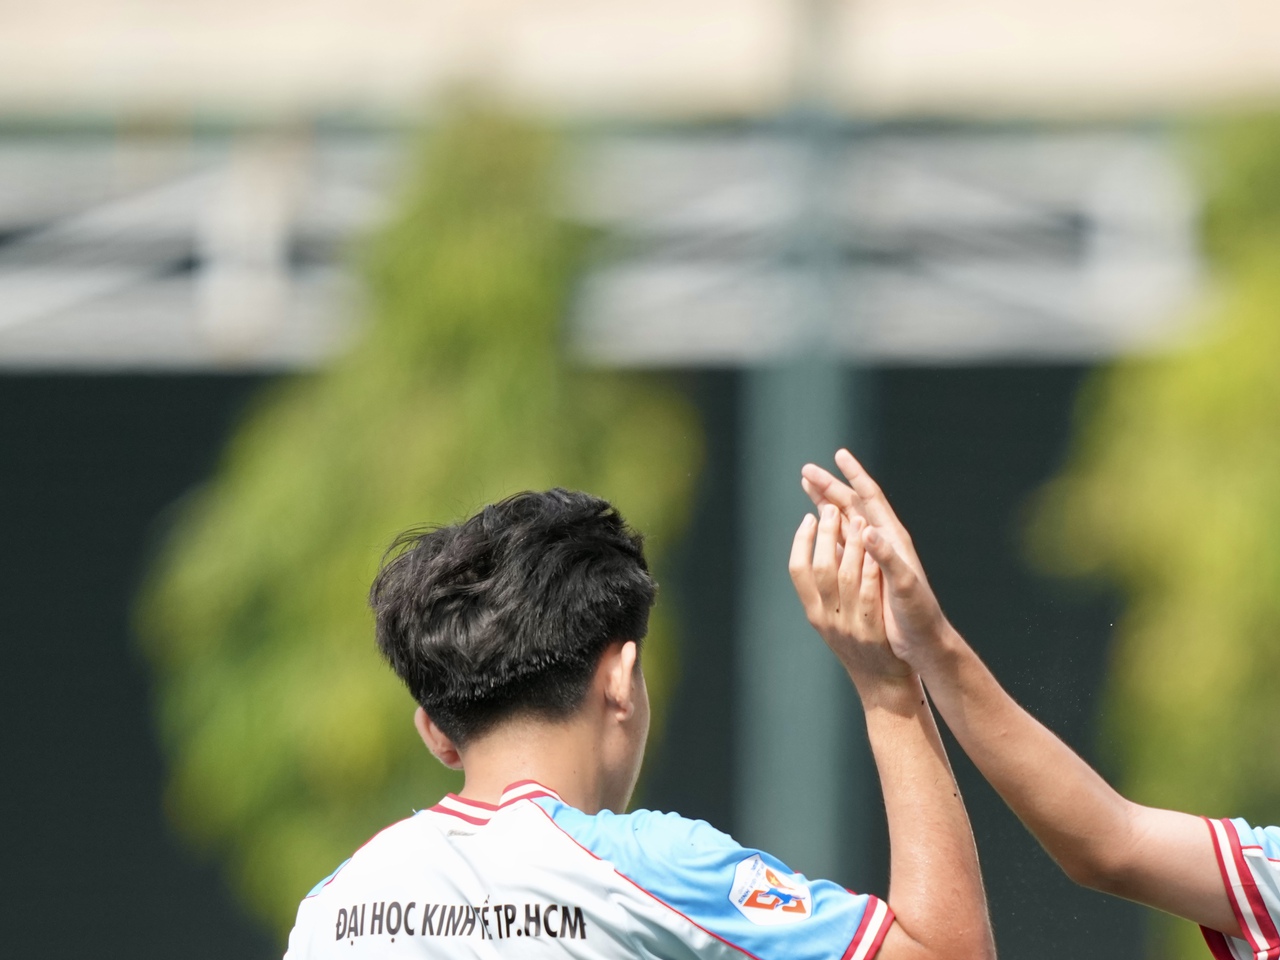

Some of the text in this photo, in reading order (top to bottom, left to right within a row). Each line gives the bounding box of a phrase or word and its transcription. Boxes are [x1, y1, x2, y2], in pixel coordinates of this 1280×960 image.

[335, 903, 366, 946] ĐẠI
[370, 901, 416, 943] HỌC
[421, 902, 476, 937] KINH
[493, 903, 587, 940] TP.HCM
